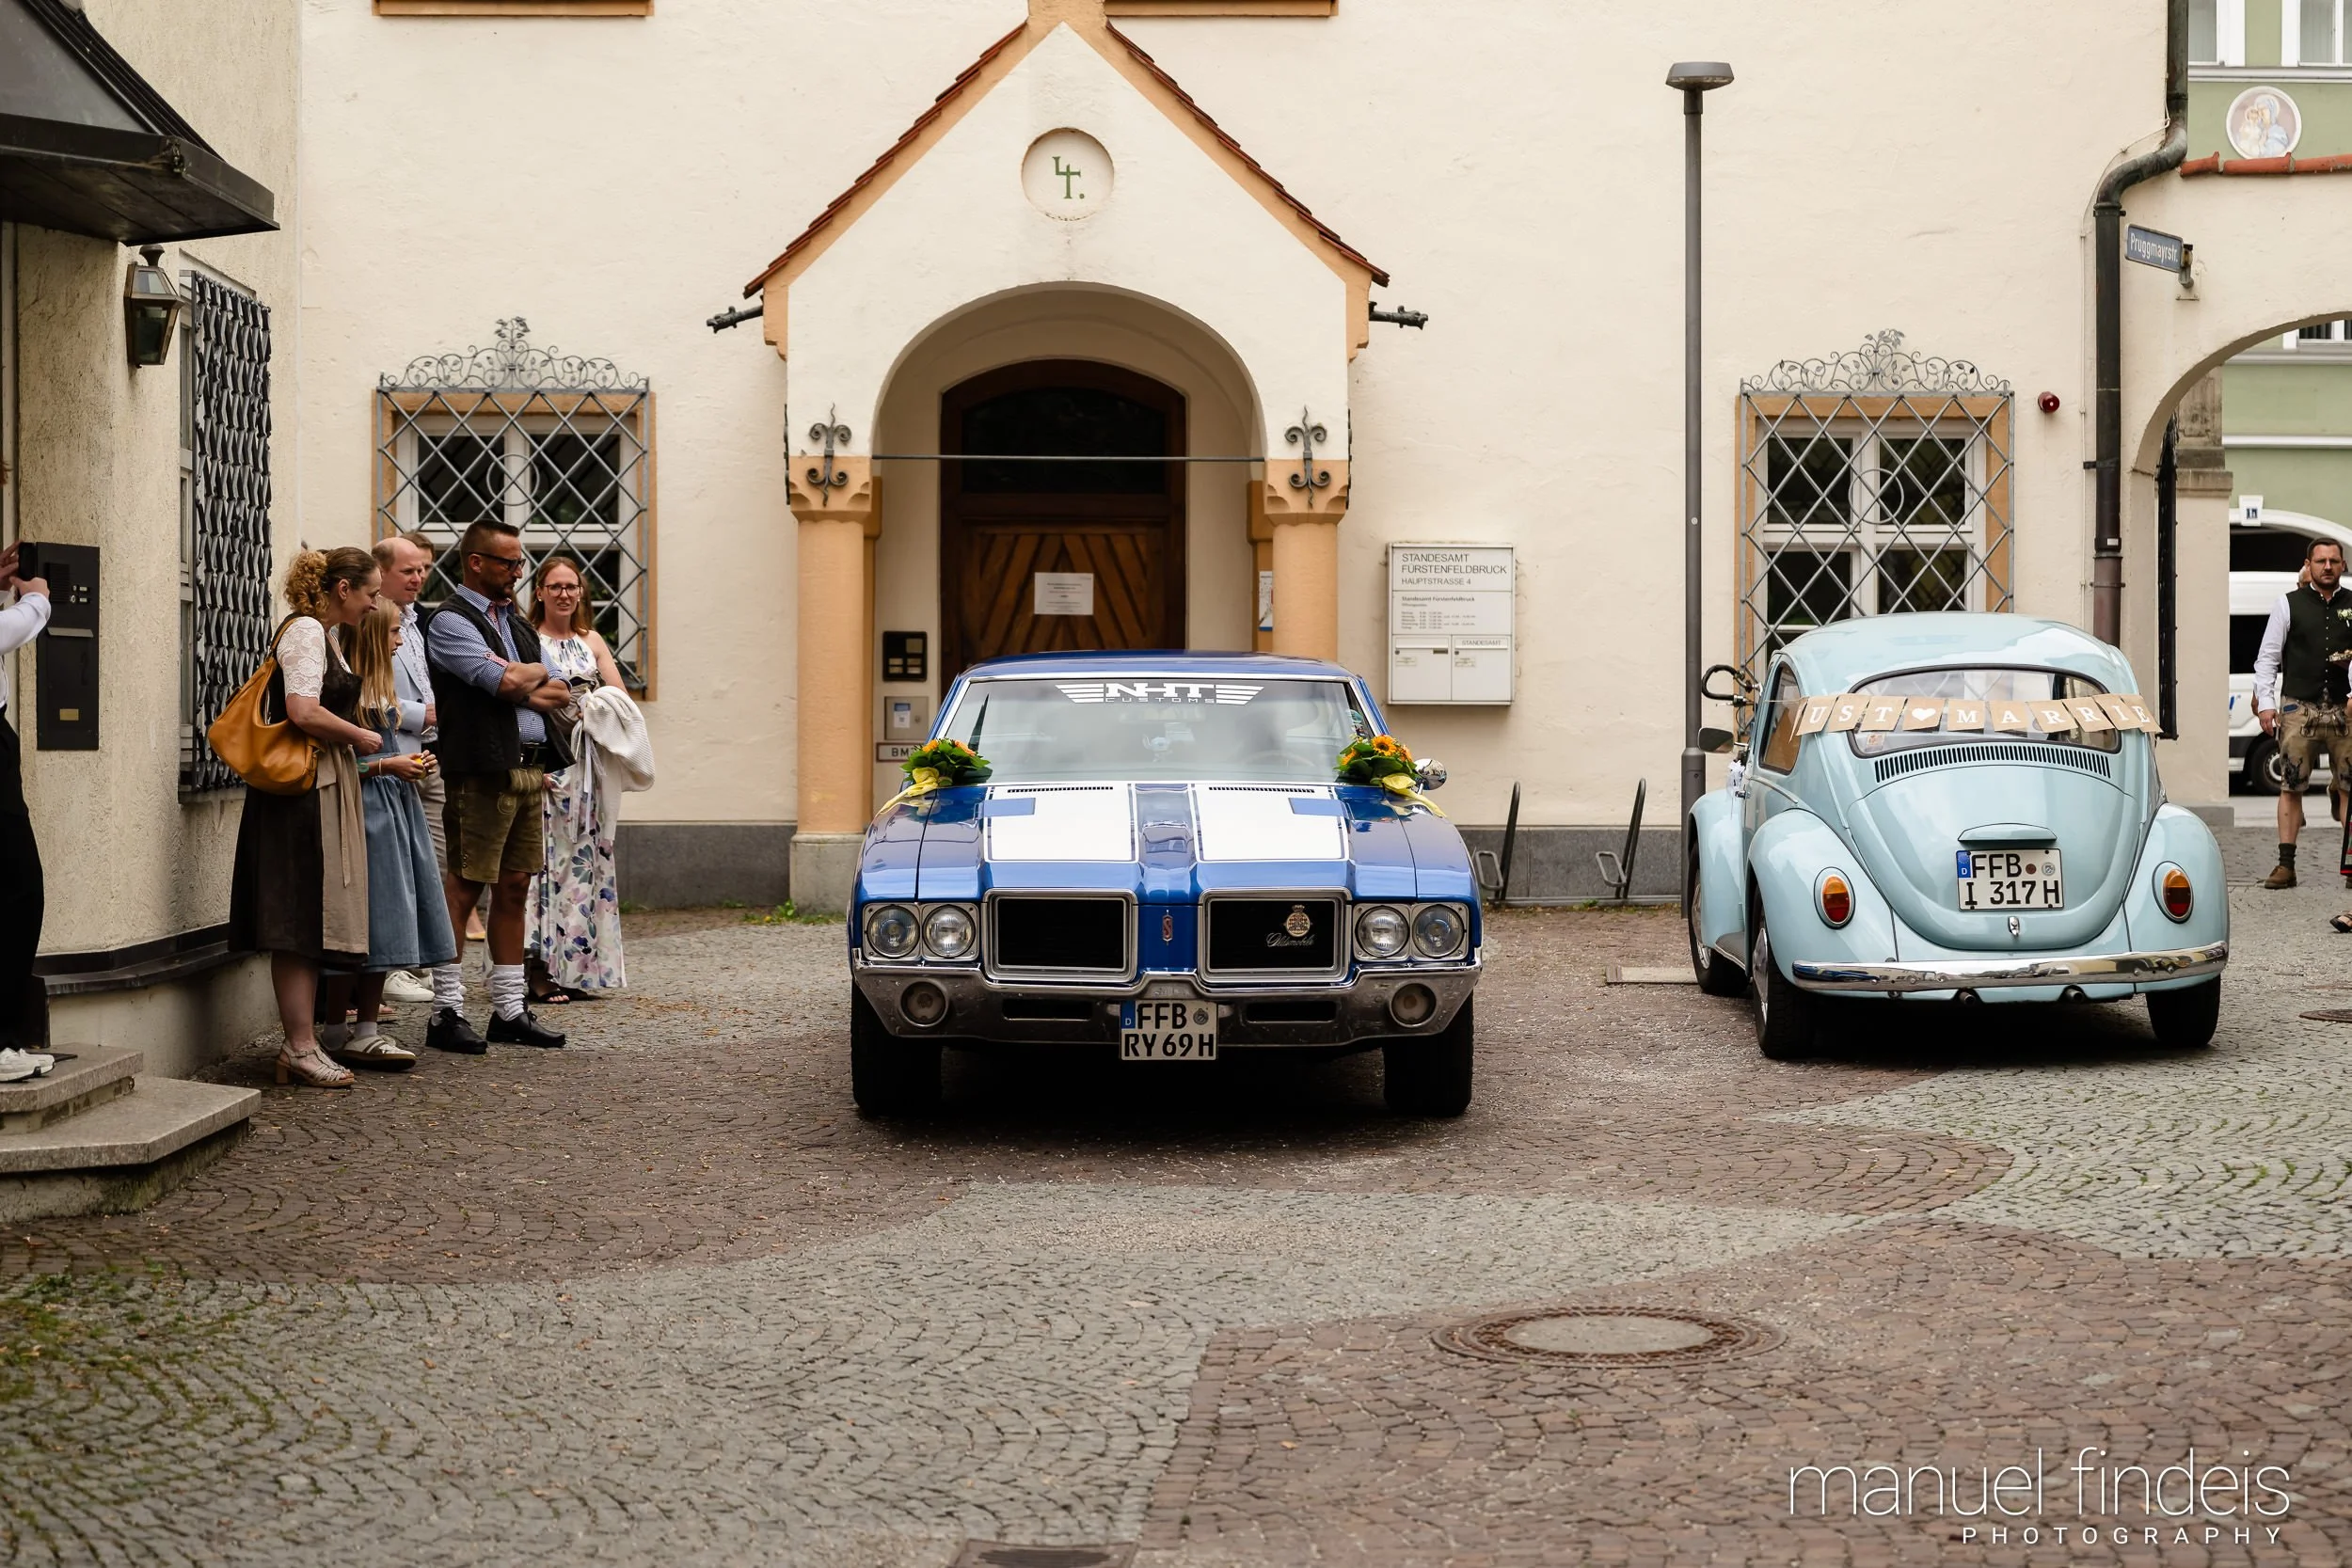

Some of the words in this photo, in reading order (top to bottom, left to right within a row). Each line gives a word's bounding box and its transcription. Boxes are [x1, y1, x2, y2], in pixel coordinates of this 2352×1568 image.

[1402, 553, 1470, 562] STANDESAMT
[1401, 563, 1507, 575] FÜRSTENFELDBRUCK
[1105, 682, 1215, 698] NHT
[1809, 705, 1893, 724] UST
[1971, 853, 2023, 879] FFB
[1990, 880, 2037, 905] 317
[1136, 1003, 1187, 1030] FFB
[1124, 1033, 1157, 1057] RY
